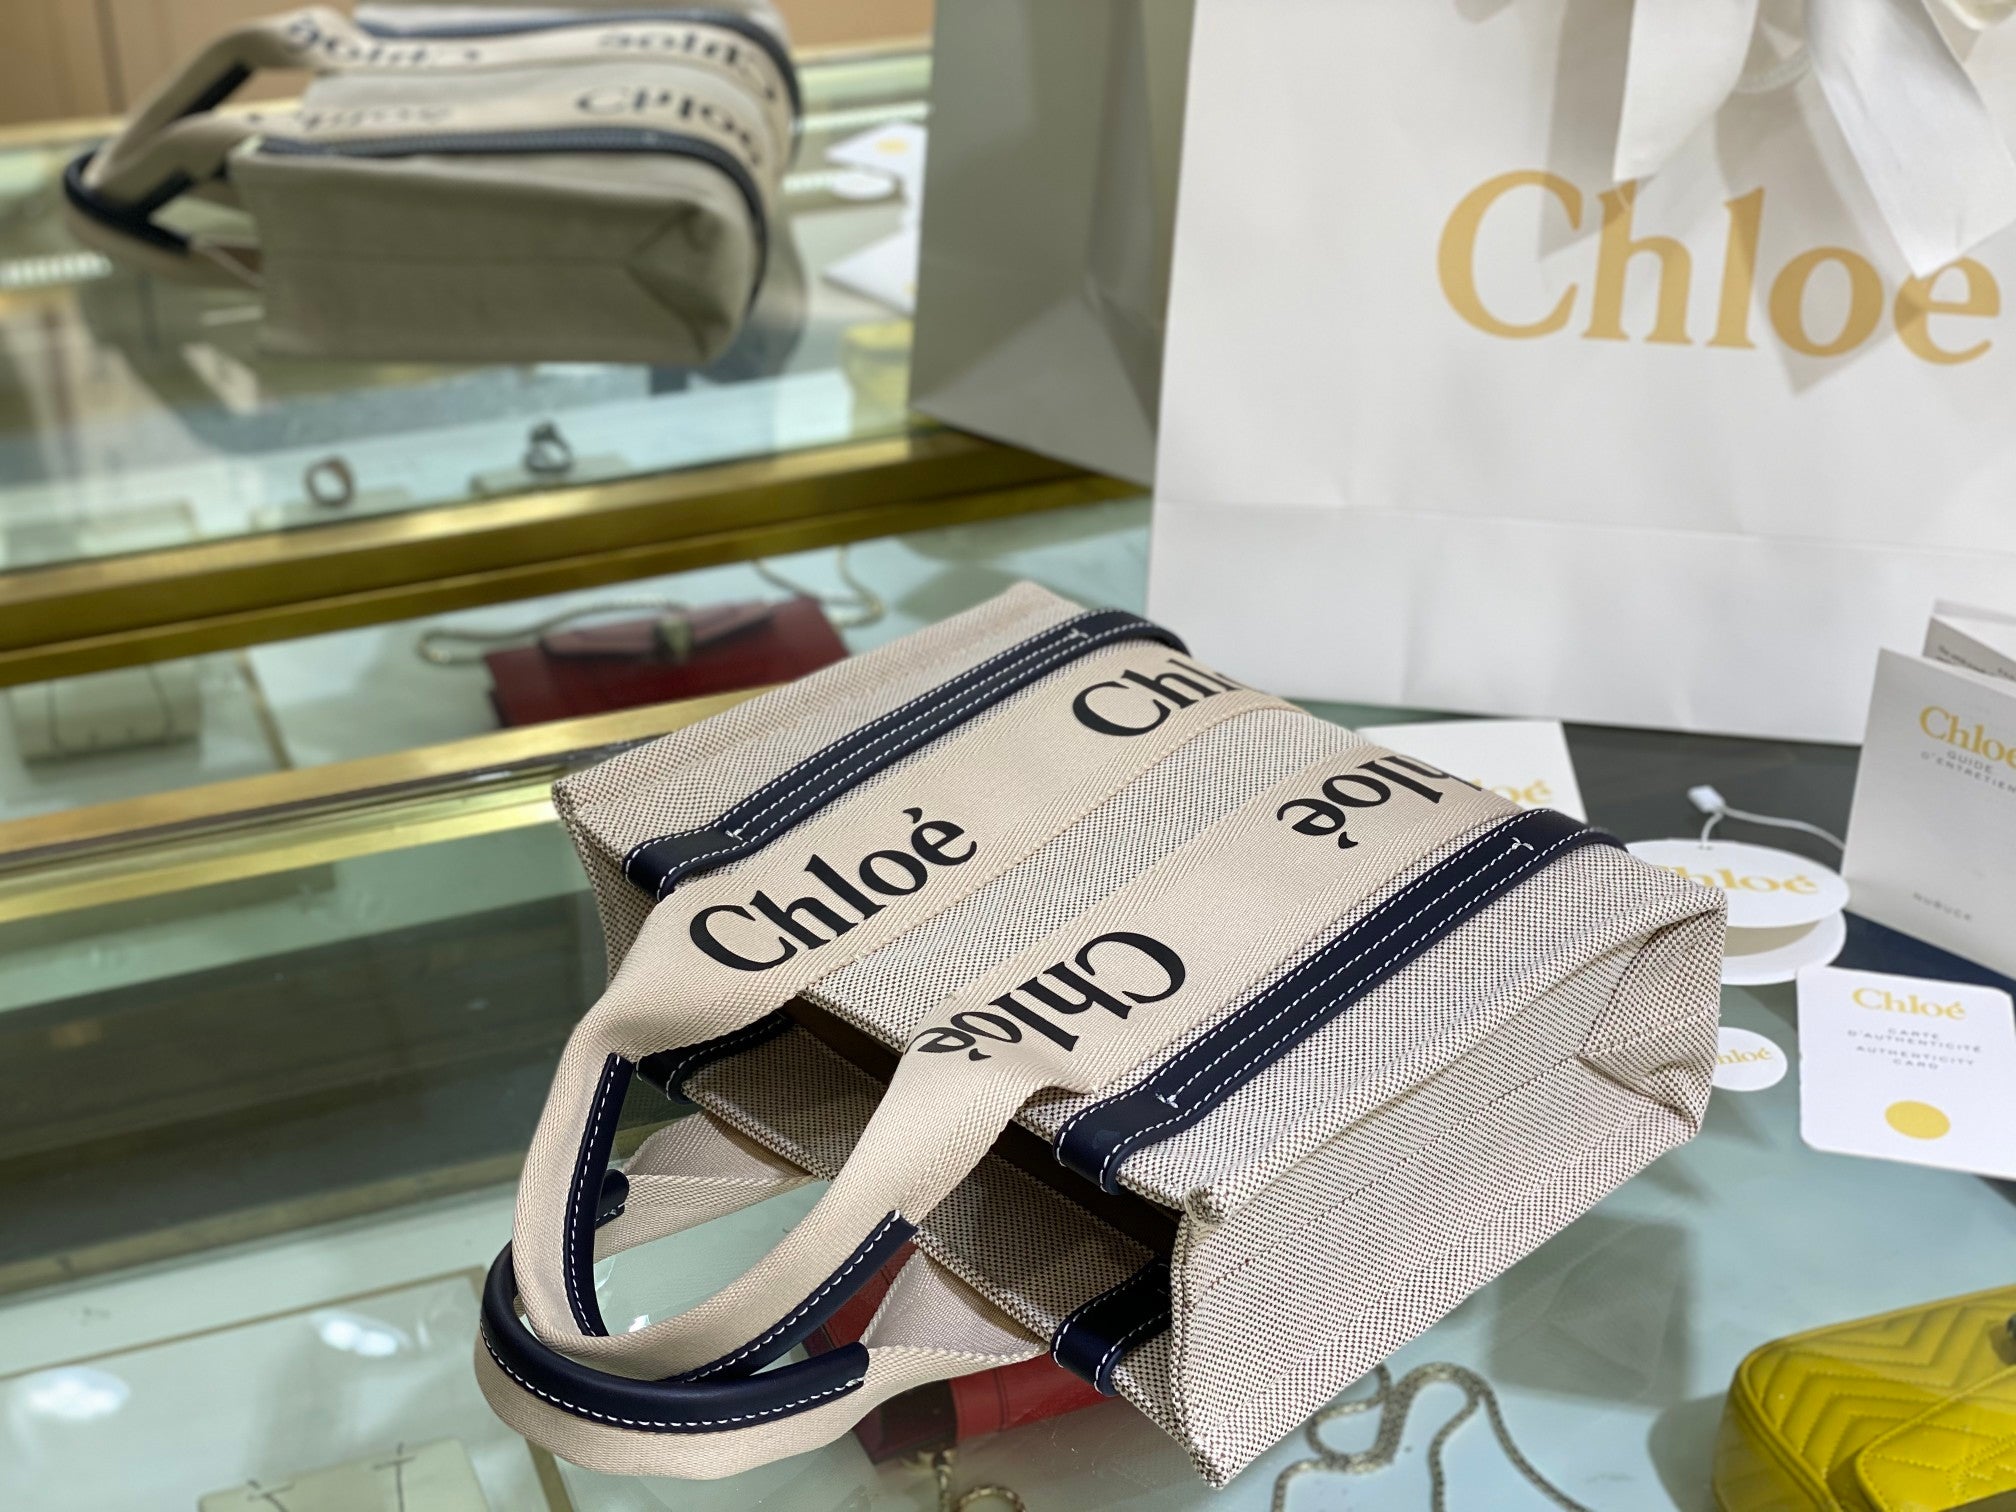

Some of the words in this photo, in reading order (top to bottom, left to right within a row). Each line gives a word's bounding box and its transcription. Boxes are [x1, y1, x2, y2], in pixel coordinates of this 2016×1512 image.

[1072, 658, 1264, 737] Chl
[1946, 751, 1993, 774] GUIDE
[1276, 755, 1482, 849] hloé
[689, 807, 978, 972] Chloé
[902, 931, 1186, 1061] Chloé
[1852, 987, 1967, 1020] Chloé
[1887, 1027, 1939, 1040] CARTE
[1856, 1045, 1974, 1066] AUTHENTICITY
[1893, 1057, 1939, 1070] CARD
